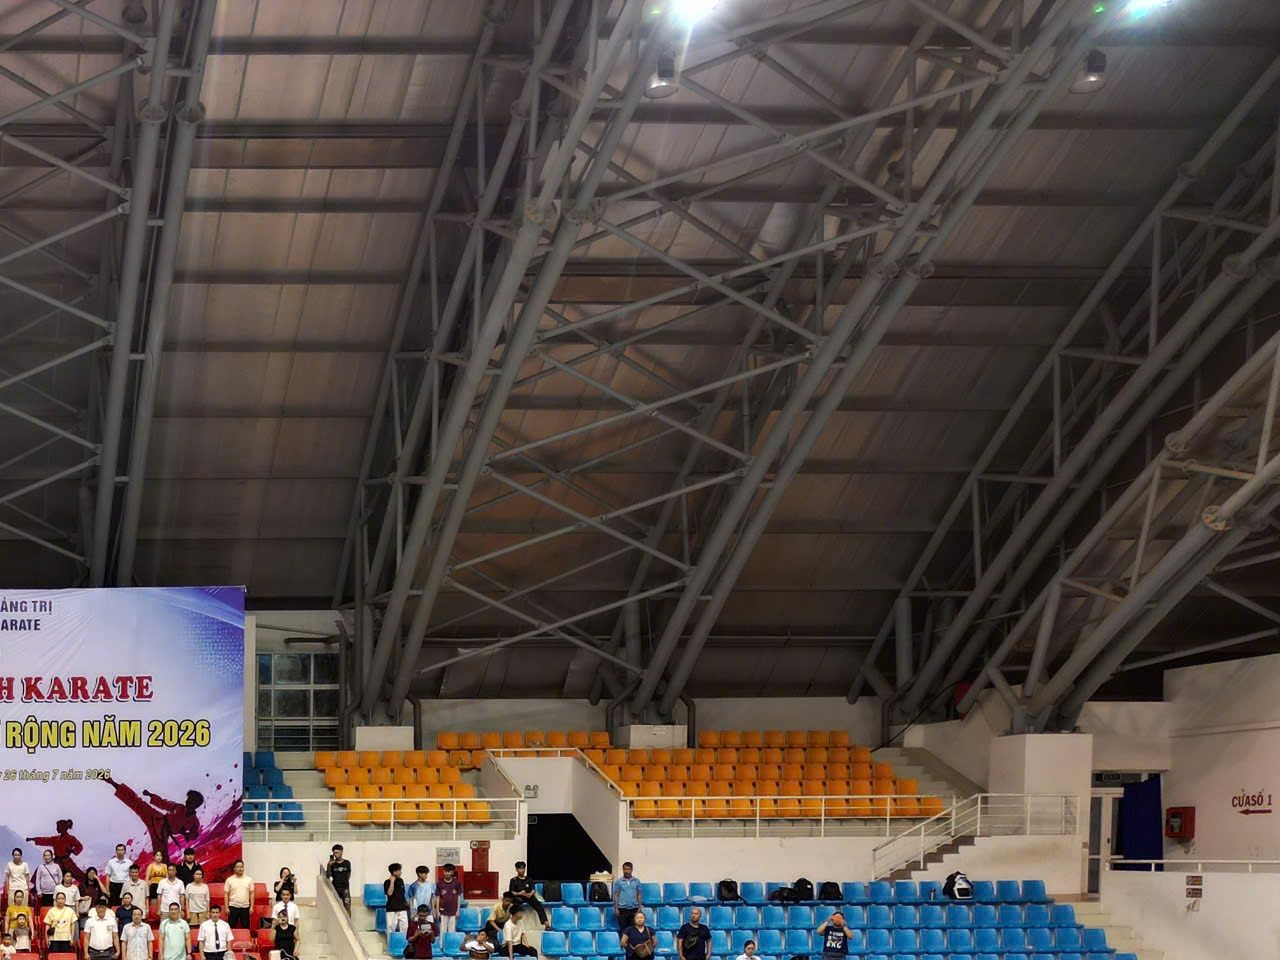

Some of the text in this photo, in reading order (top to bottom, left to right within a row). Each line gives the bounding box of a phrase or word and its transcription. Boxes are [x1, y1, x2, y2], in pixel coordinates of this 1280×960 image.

[31, 600, 53, 615] TRỊ
[21, 676, 154, 703] KARATE
[6, 715, 76, 754] RỘNG
[82, 715, 141, 748] NĂM
[147, 719, 210, 748] 2026
[3, 769, 17, 781] 26
[19, 769, 49, 783] tháng
[52, 769, 59, 780] 7
[60, 769, 83, 780] năm
[85, 769, 111, 780] 2026
[1267, 794, 1272, 806] 1
